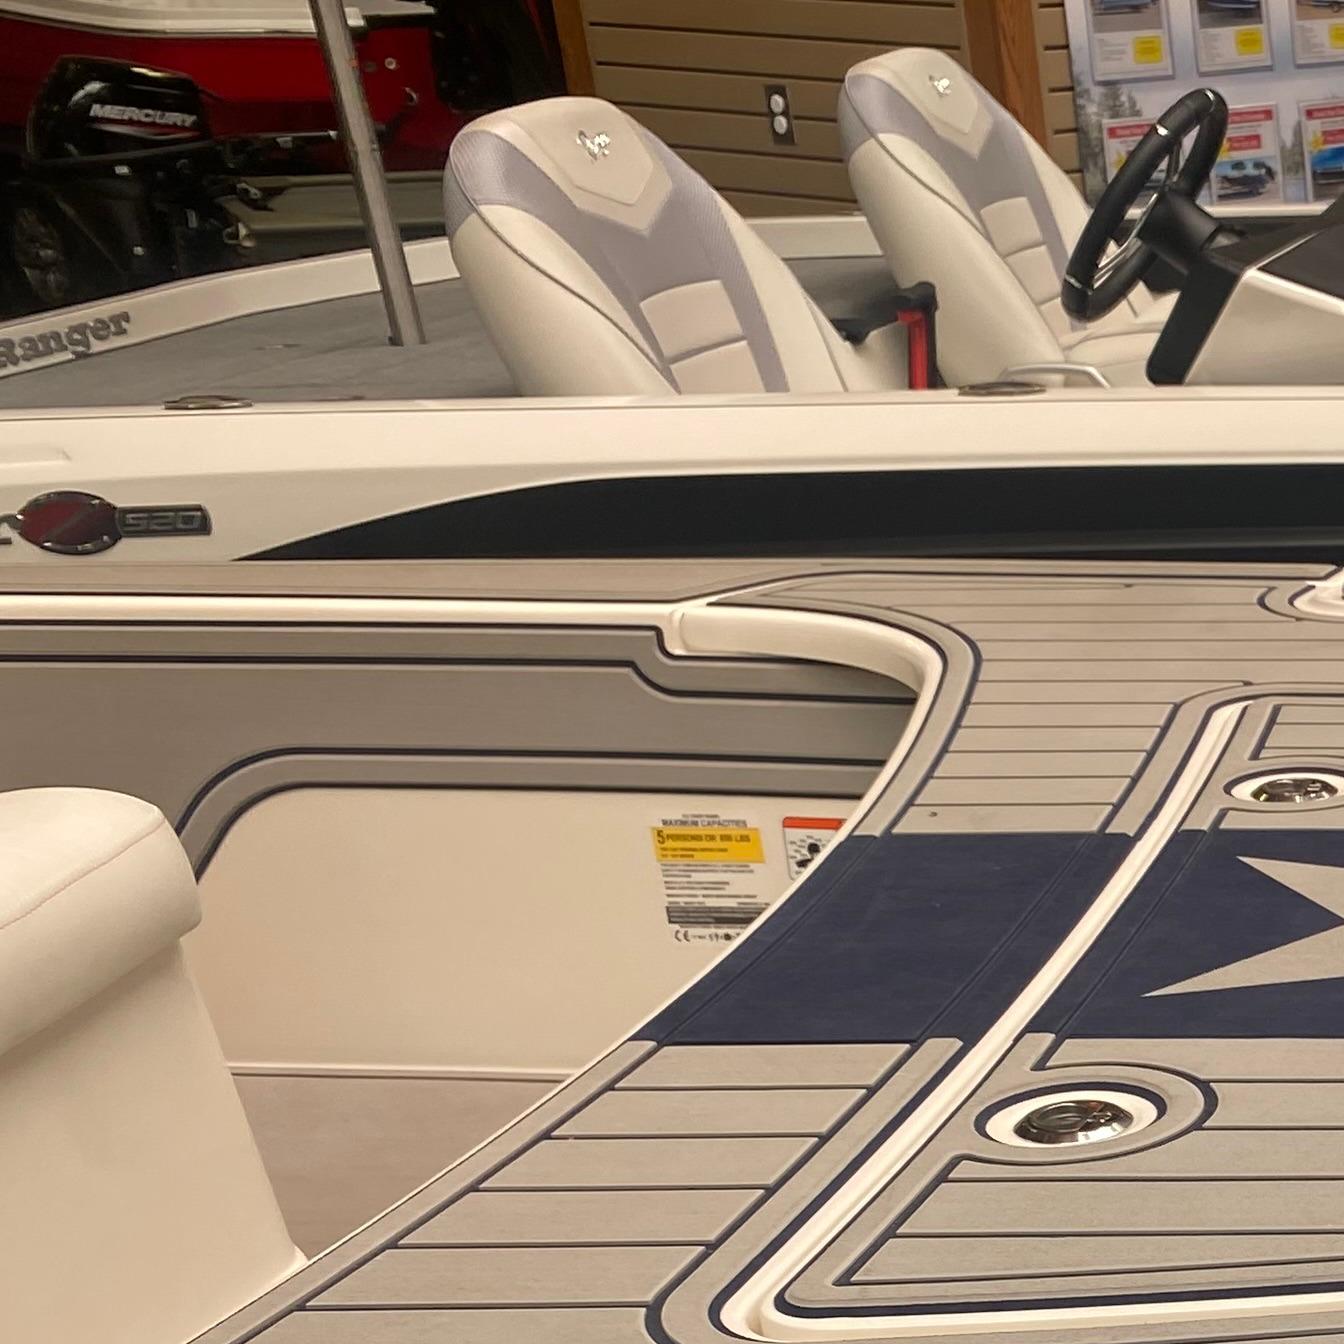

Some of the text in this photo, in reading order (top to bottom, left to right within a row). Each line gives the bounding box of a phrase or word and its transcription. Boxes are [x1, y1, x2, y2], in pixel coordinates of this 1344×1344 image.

[89, 103, 197, 127] MERCURY
[124, 511, 202, 531] 520
[656, 829, 666, 844] 5
